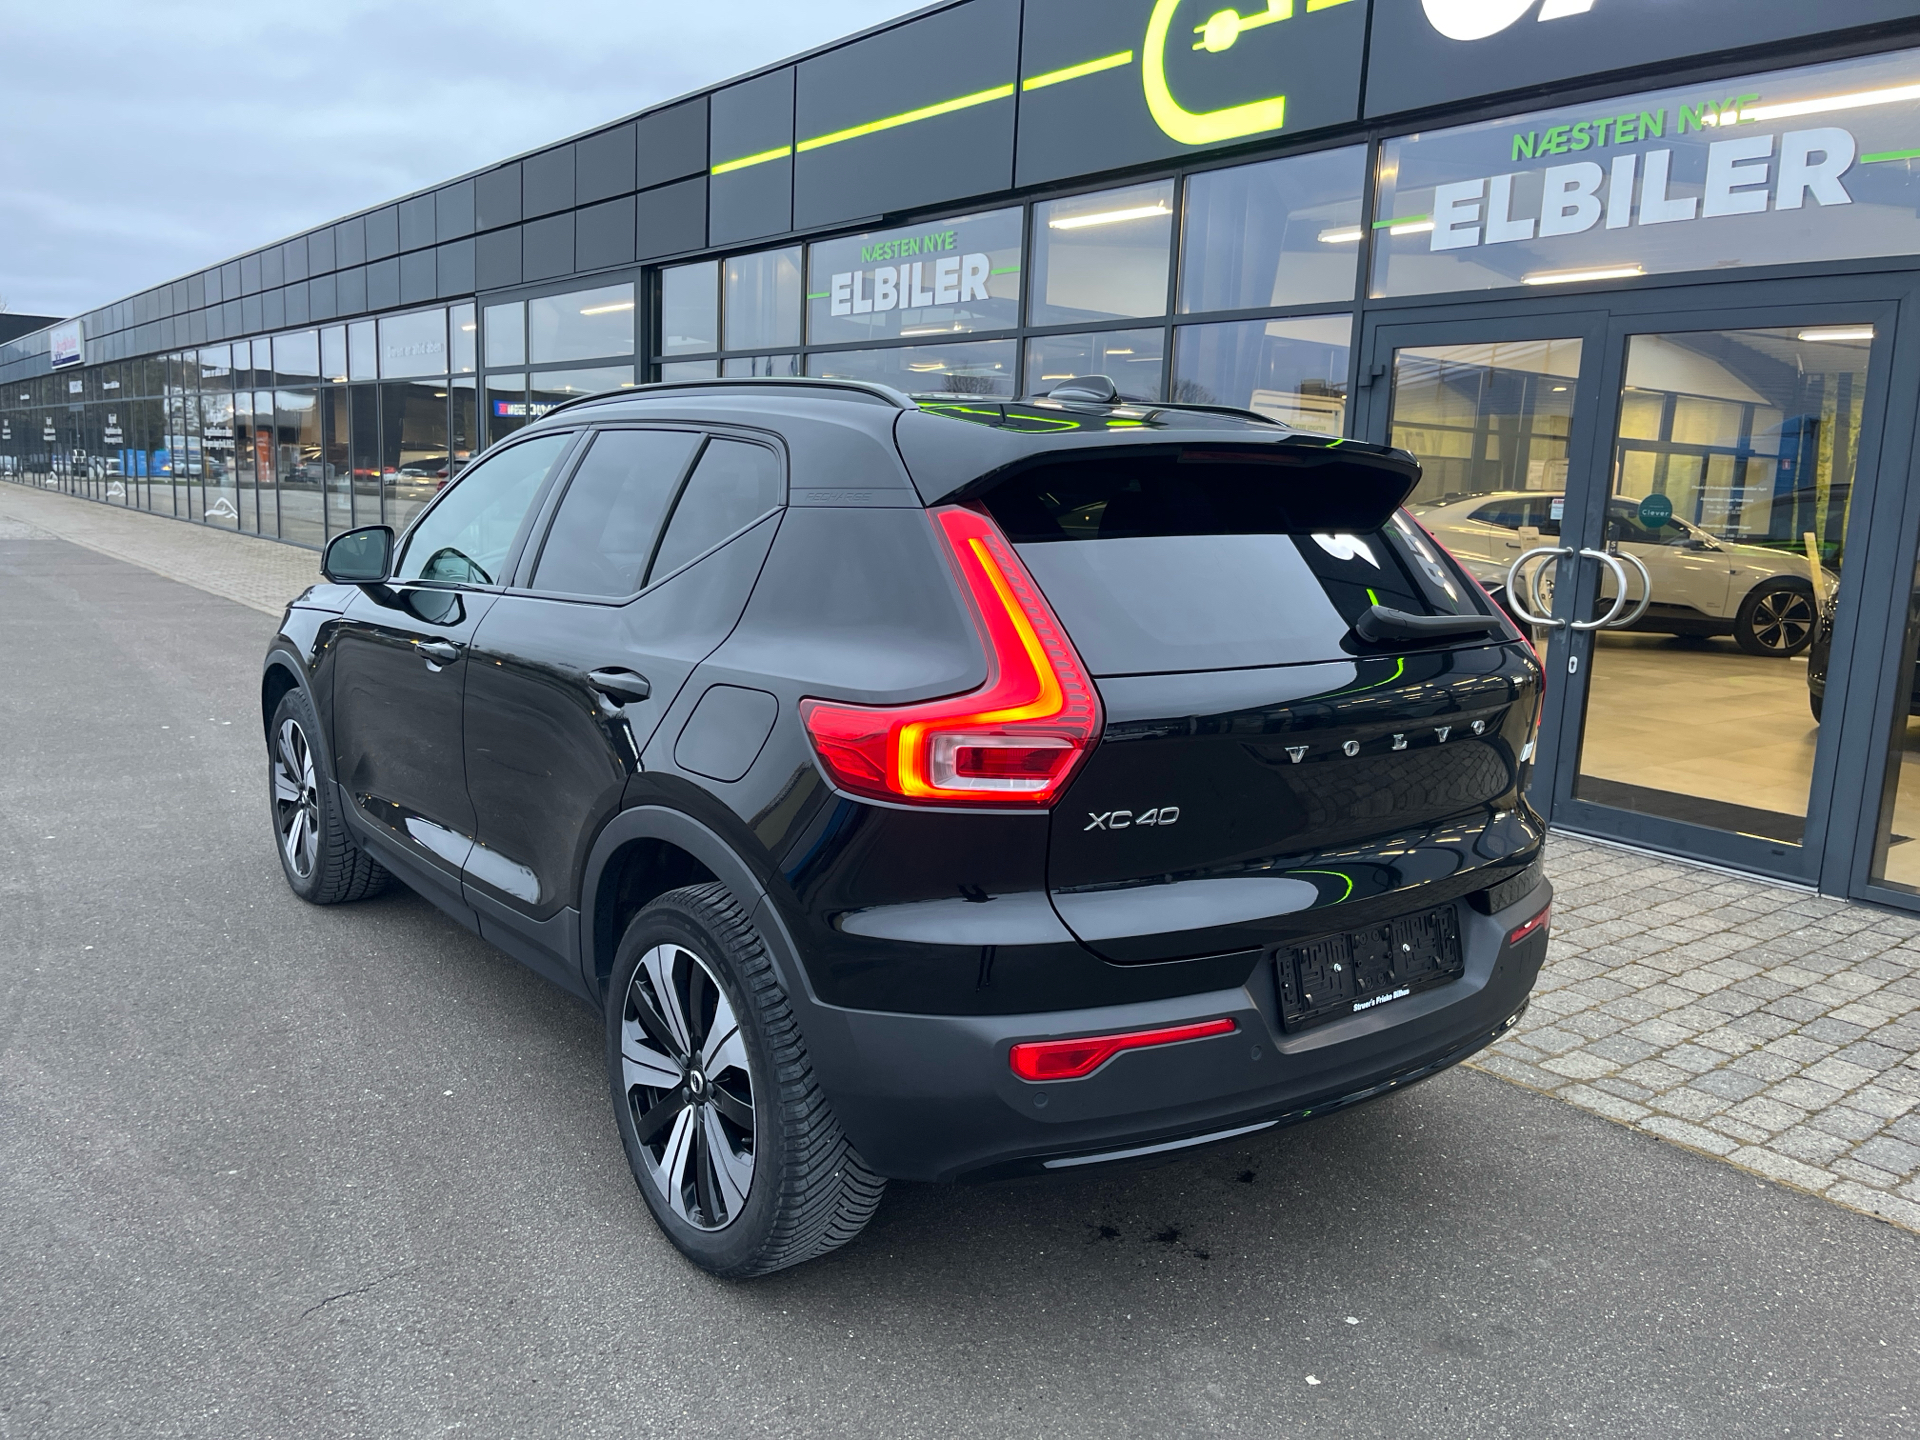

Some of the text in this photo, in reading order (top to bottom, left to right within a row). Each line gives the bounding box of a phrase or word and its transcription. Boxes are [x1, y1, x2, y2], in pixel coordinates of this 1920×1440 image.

[1511, 93, 1760, 162] NÆSTEN NYE
[1430, 127, 1857, 252] ELBILER
[862, 231, 955, 263] NÆSTEN NYE
[830, 252, 990, 316] ELBILER
[806, 493, 872, 502] RECHARGE
[1642, 509, 1670, 517] Clever
[1286, 721, 1486, 764] VOLVO
[1084, 807, 1180, 832] XC40
